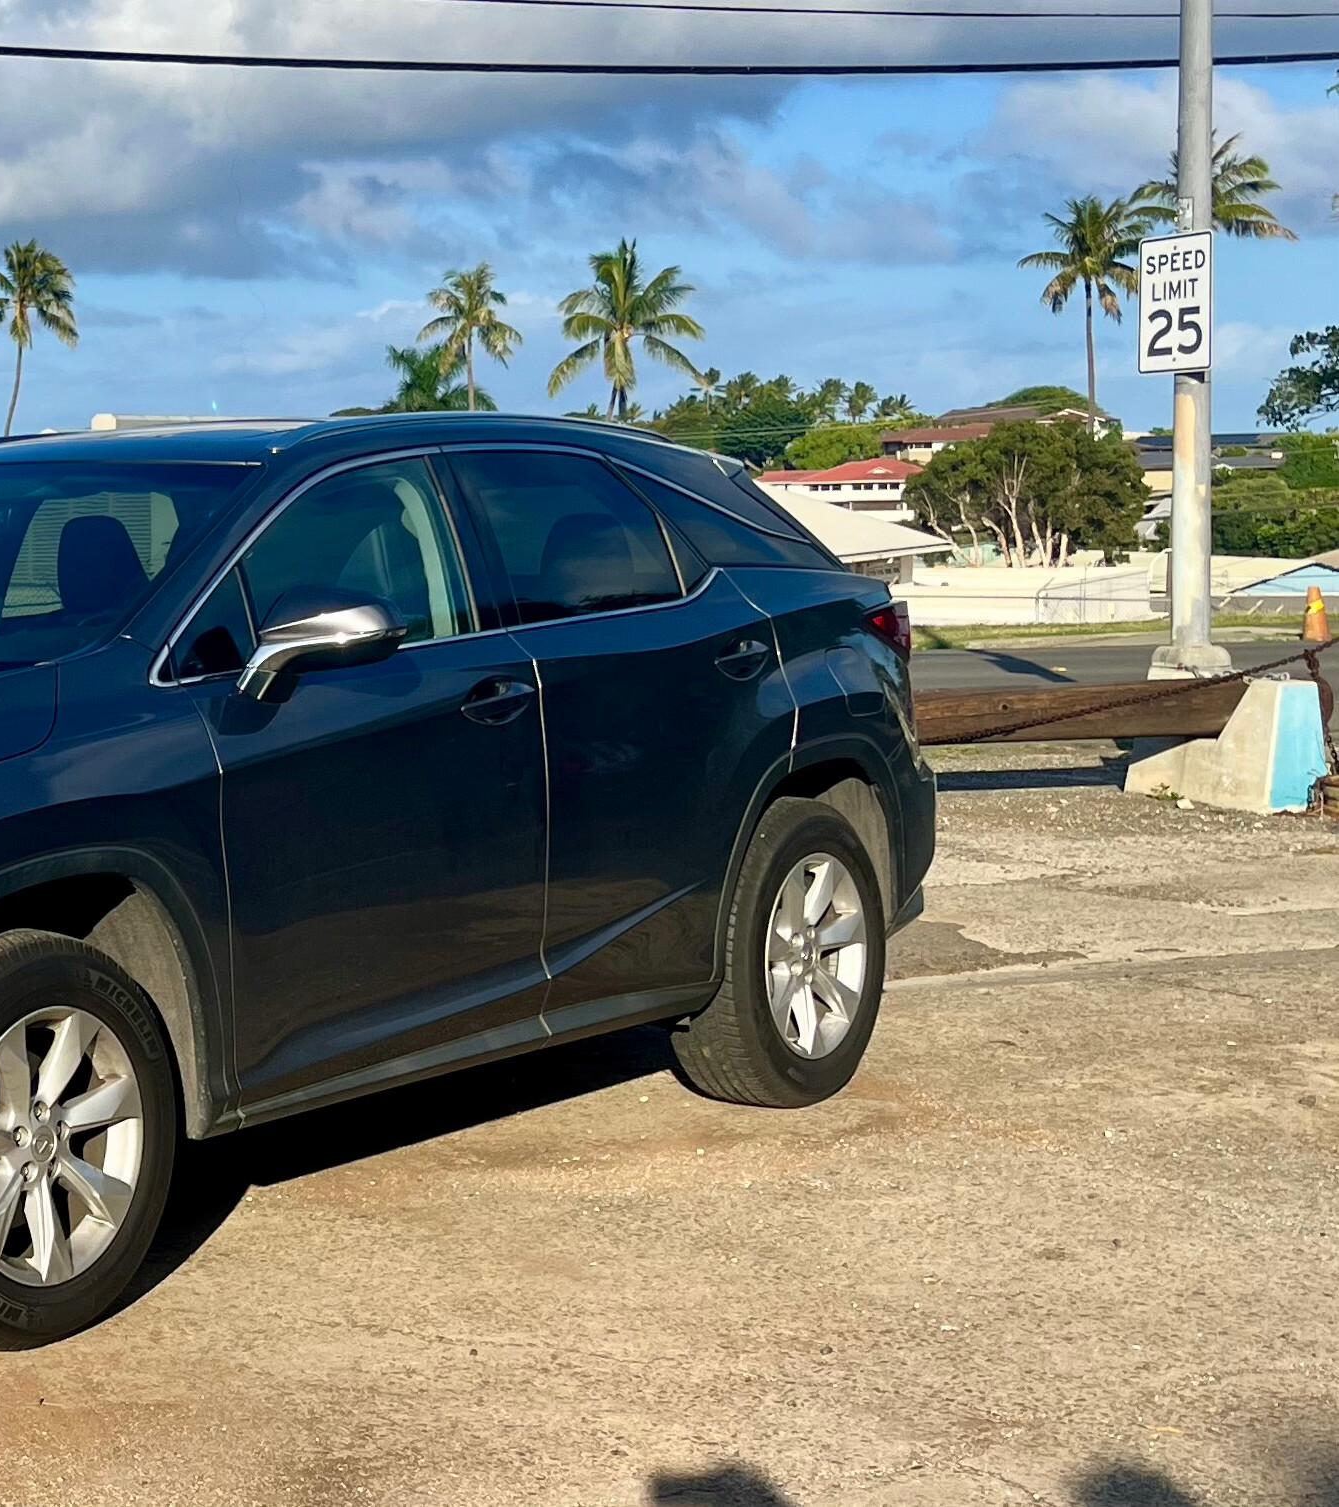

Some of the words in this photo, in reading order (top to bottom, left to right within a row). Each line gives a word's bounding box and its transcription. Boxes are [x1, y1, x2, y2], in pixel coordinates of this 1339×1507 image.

[1146, 250, 1206, 275] SPEED
[1152, 278, 1198, 302] LIMIT
[1147, 306, 1203, 357] 25
[92, 975, 158, 1055] MICHELIN
